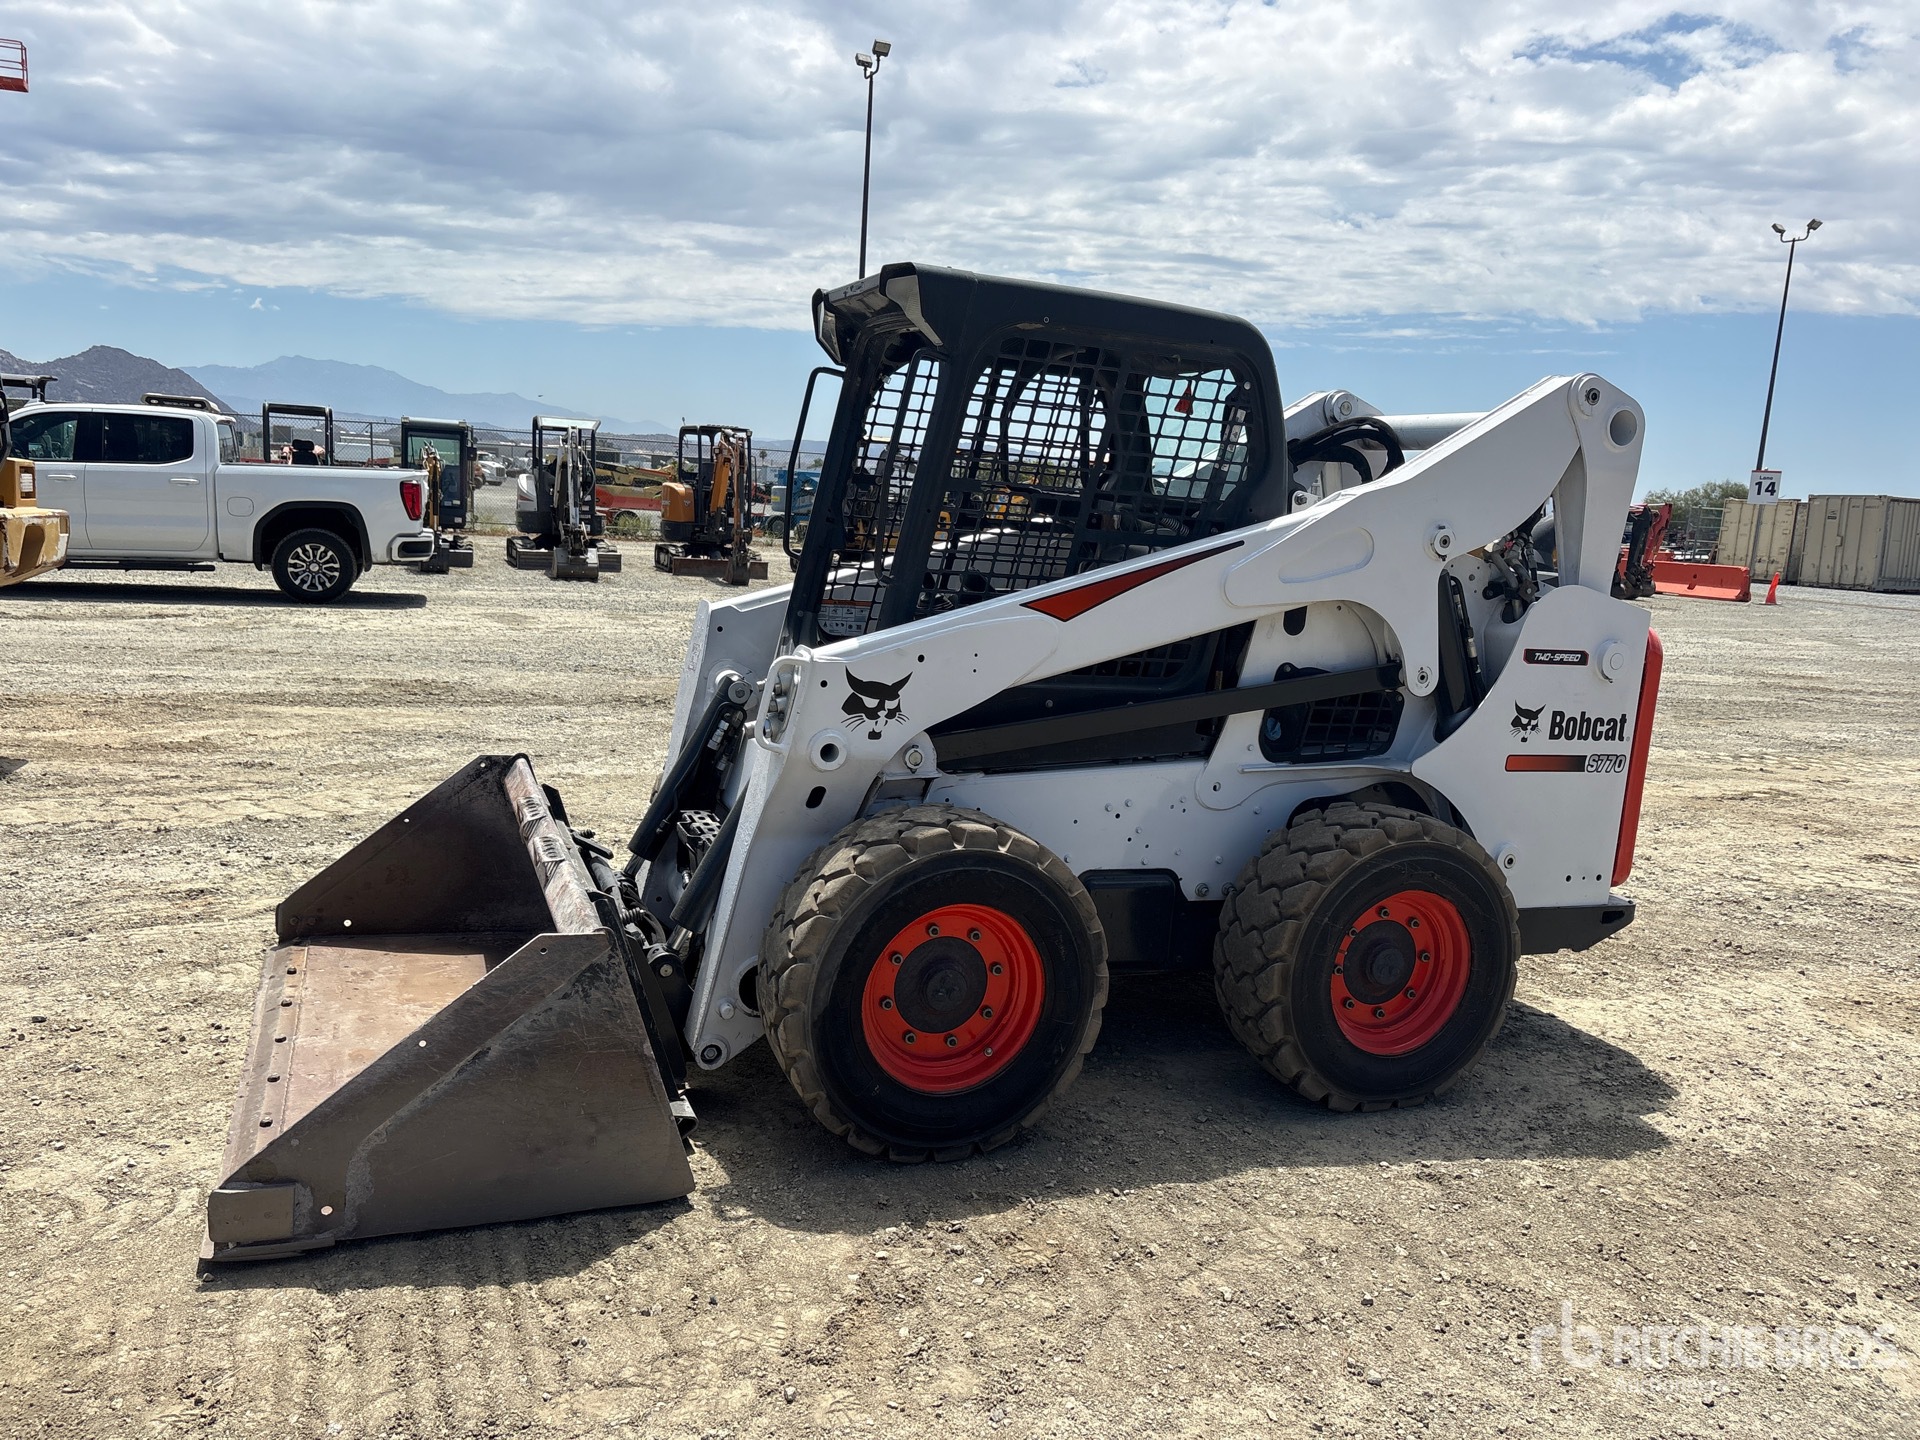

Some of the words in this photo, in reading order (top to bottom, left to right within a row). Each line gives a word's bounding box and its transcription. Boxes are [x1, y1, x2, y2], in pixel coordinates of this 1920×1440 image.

[1755, 481, 1776, 496] 14
[1534, 652, 1581, 662] TWO-SPEED
[1549, 710, 1628, 742] Bobcat
[1586, 754, 1627, 773] S770
